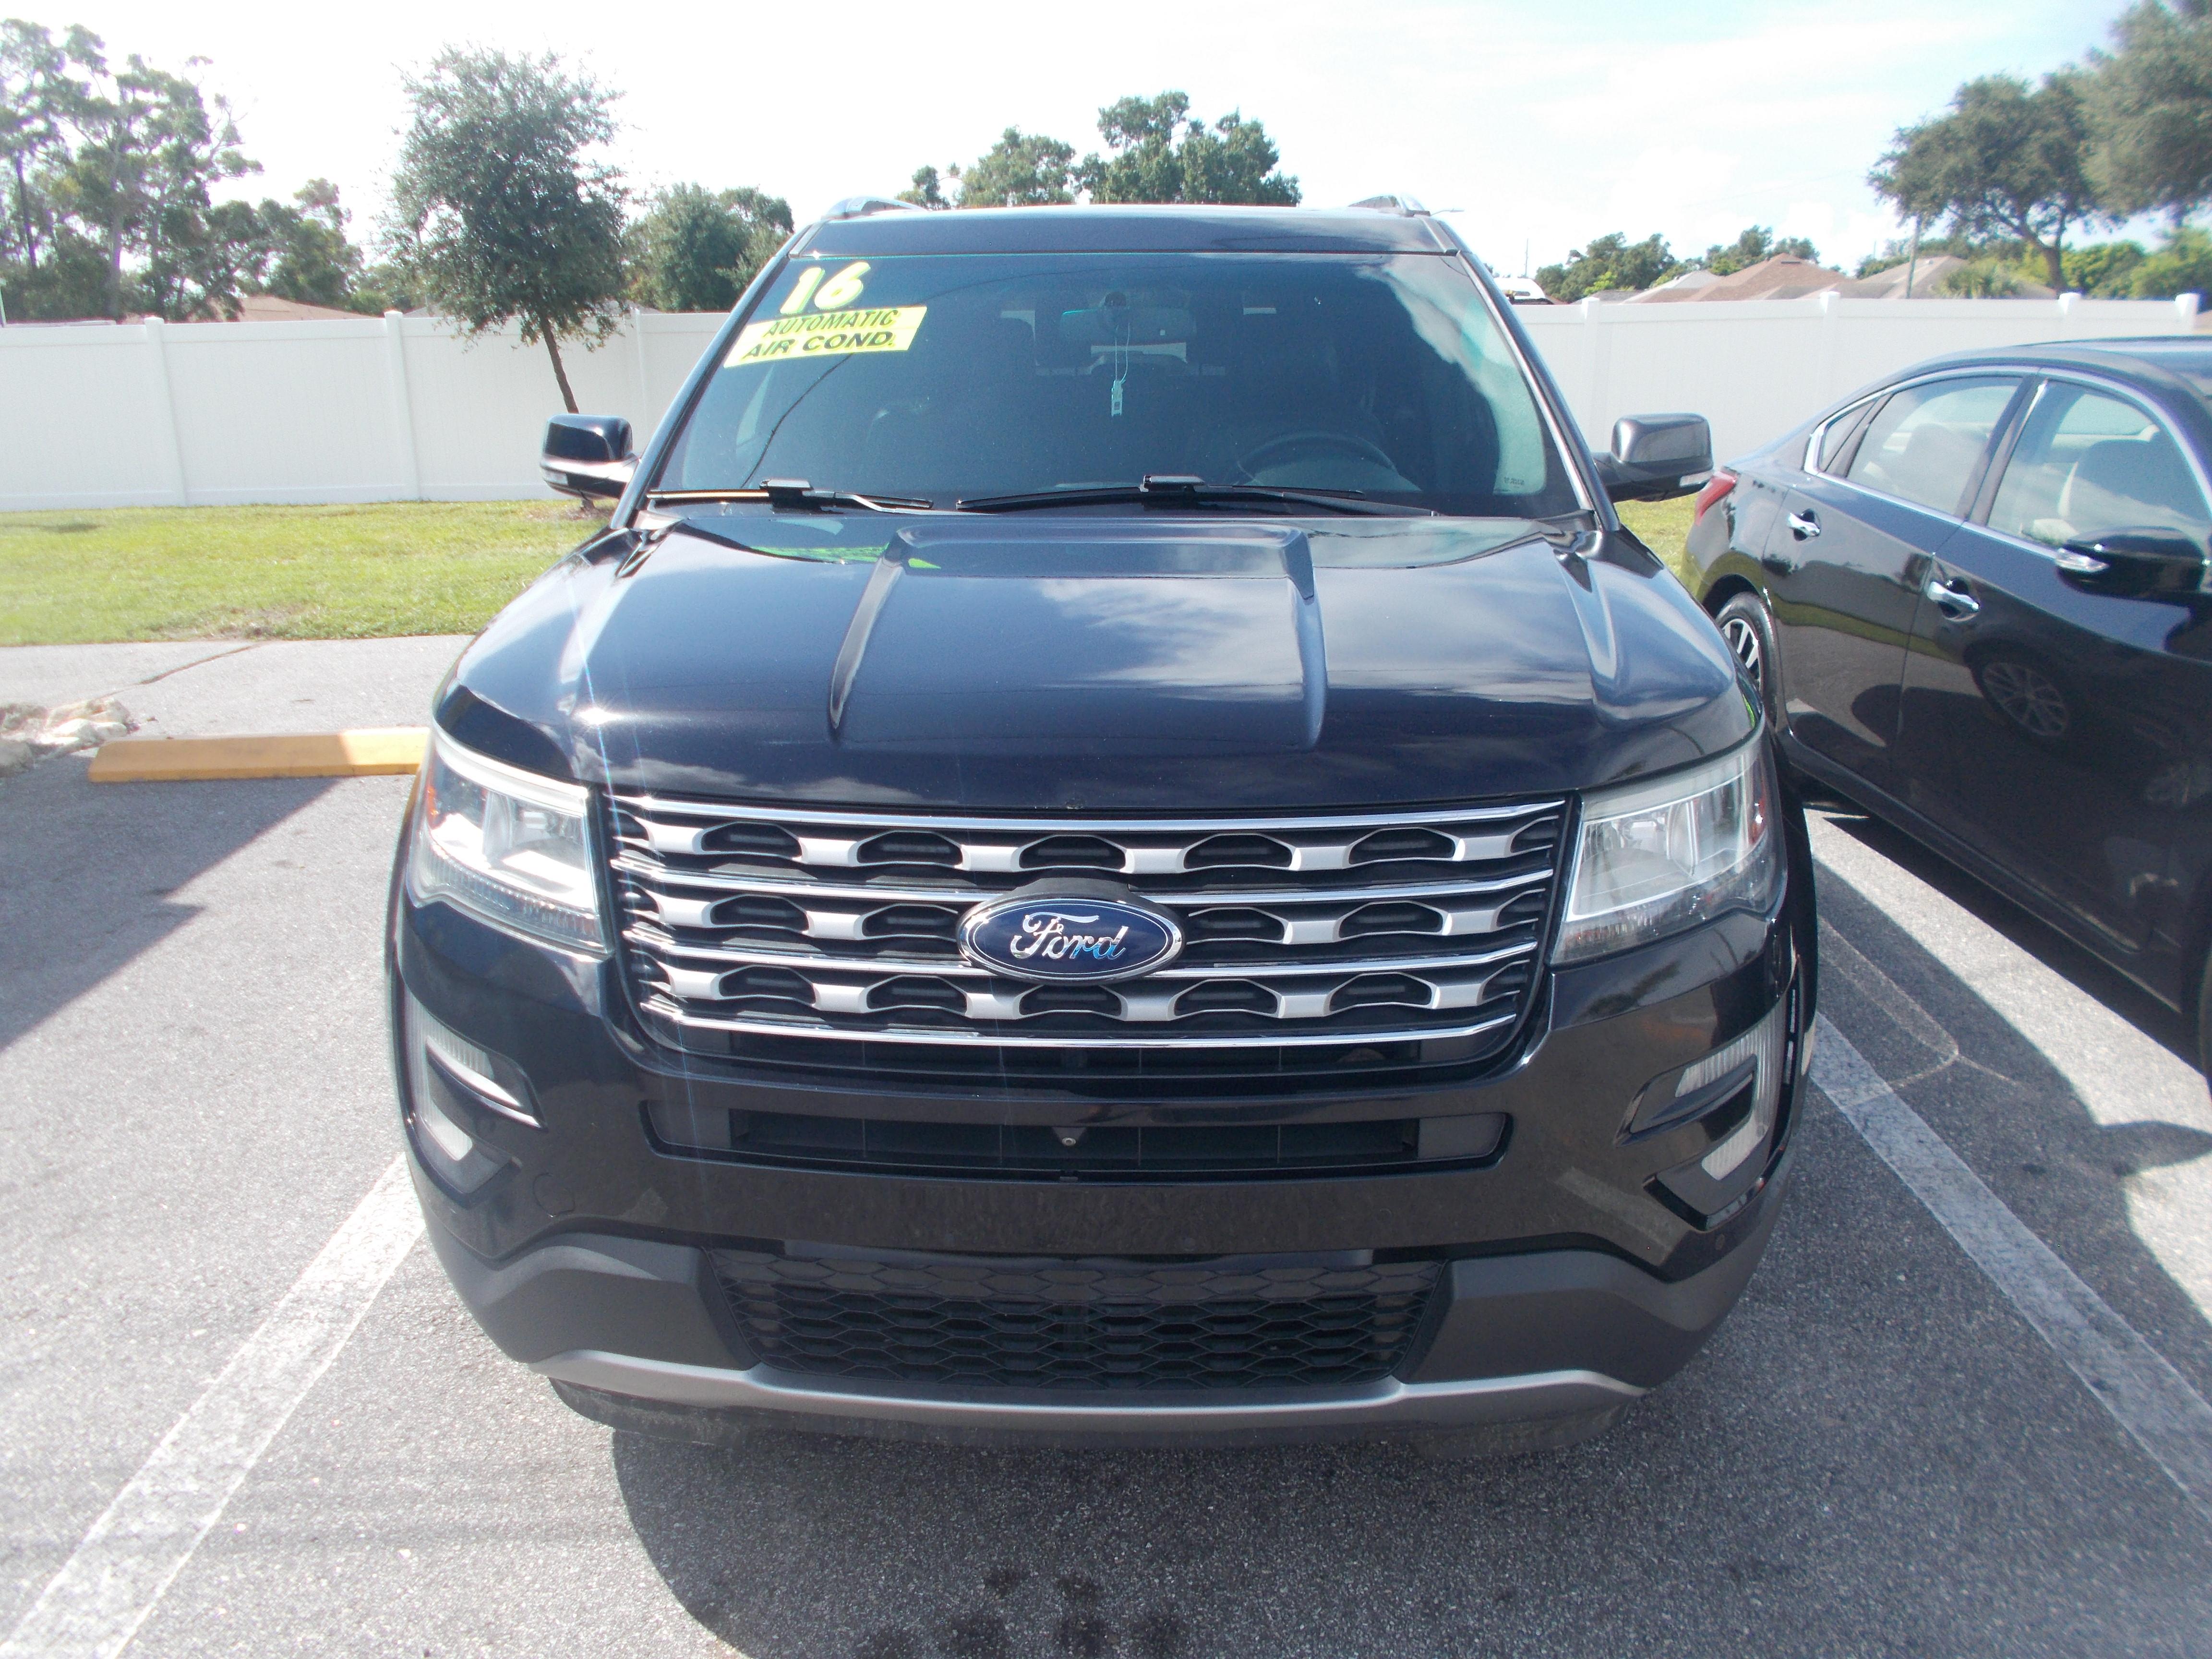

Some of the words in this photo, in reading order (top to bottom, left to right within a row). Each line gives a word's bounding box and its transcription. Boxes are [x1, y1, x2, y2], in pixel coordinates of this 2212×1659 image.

[780, 262, 871, 314] 16
[763, 309, 899, 337] AUTOMATIC
[742, 338, 795, 360] AIR
[803, 331, 894, 351] COND.
[1010, 912, 1129, 959] Ford
